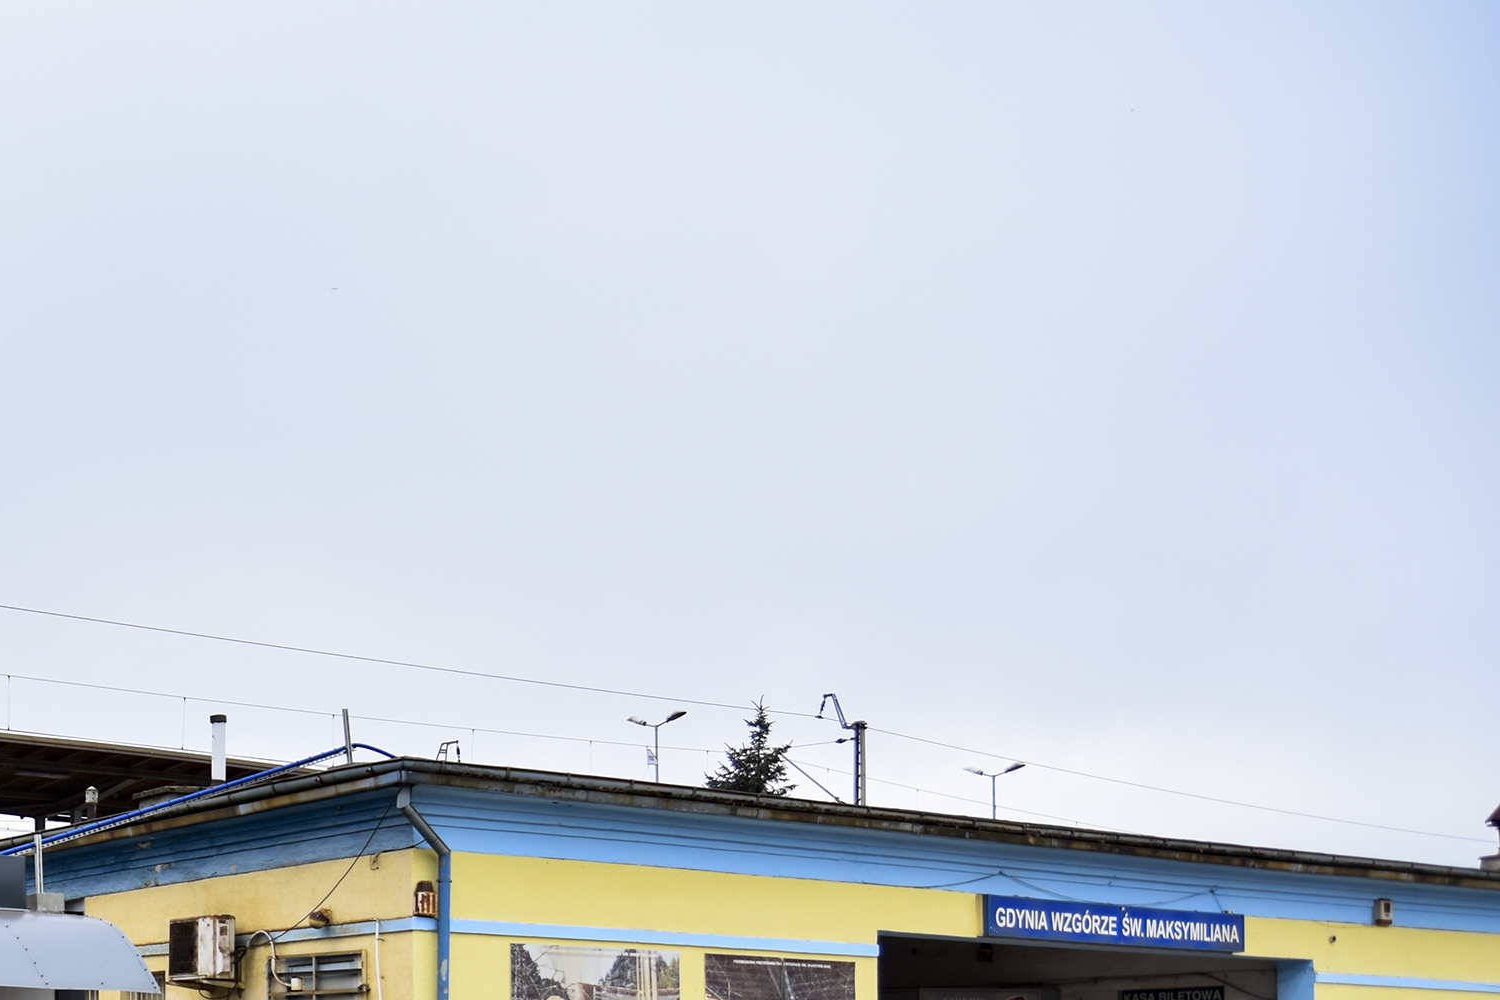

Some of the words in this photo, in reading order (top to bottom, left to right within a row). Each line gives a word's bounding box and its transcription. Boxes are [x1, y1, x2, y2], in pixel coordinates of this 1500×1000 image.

[995, 906, 1048, 931] GDYNIA
[1051, 909, 1118, 936] WZGÓRZE
[1121, 912, 1145, 938] ŚW.
[1146, 918, 1240, 943] MAKSYMILIANA
